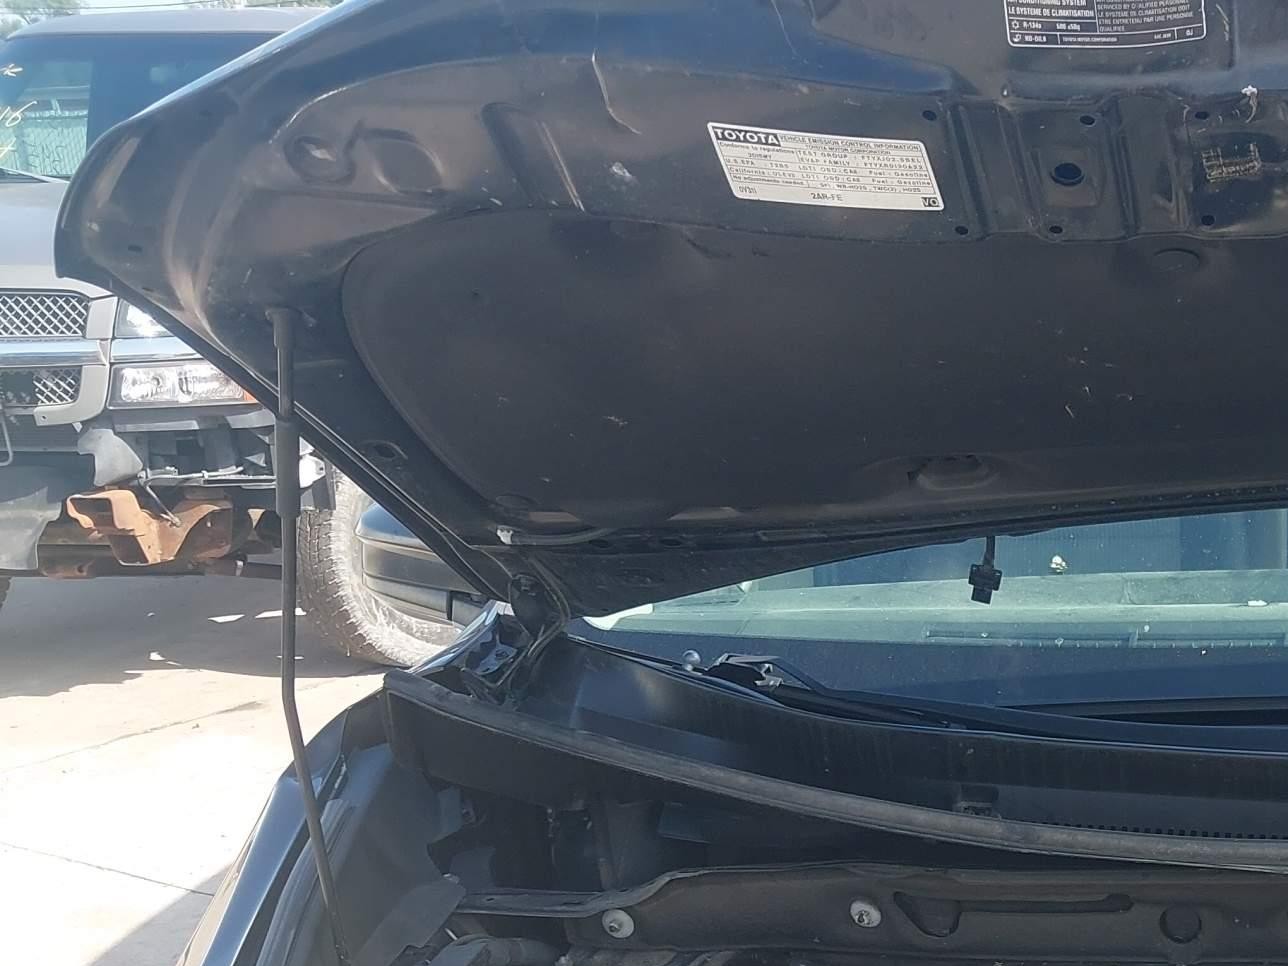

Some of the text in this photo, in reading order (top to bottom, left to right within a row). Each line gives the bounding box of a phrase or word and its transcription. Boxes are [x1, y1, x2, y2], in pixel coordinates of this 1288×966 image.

[1008, 6, 1015, 14] LE
[1051, 9, 1094, 17] CLIMATISATION
[713, 128, 779, 145] TOYOTA
[781, 135, 805, 143] VEHICLE
[808, 136, 840, 145] EMISSION
[841, 140, 872, 148] CONTROL
[810, 192, 843, 201] 2AR-FE
